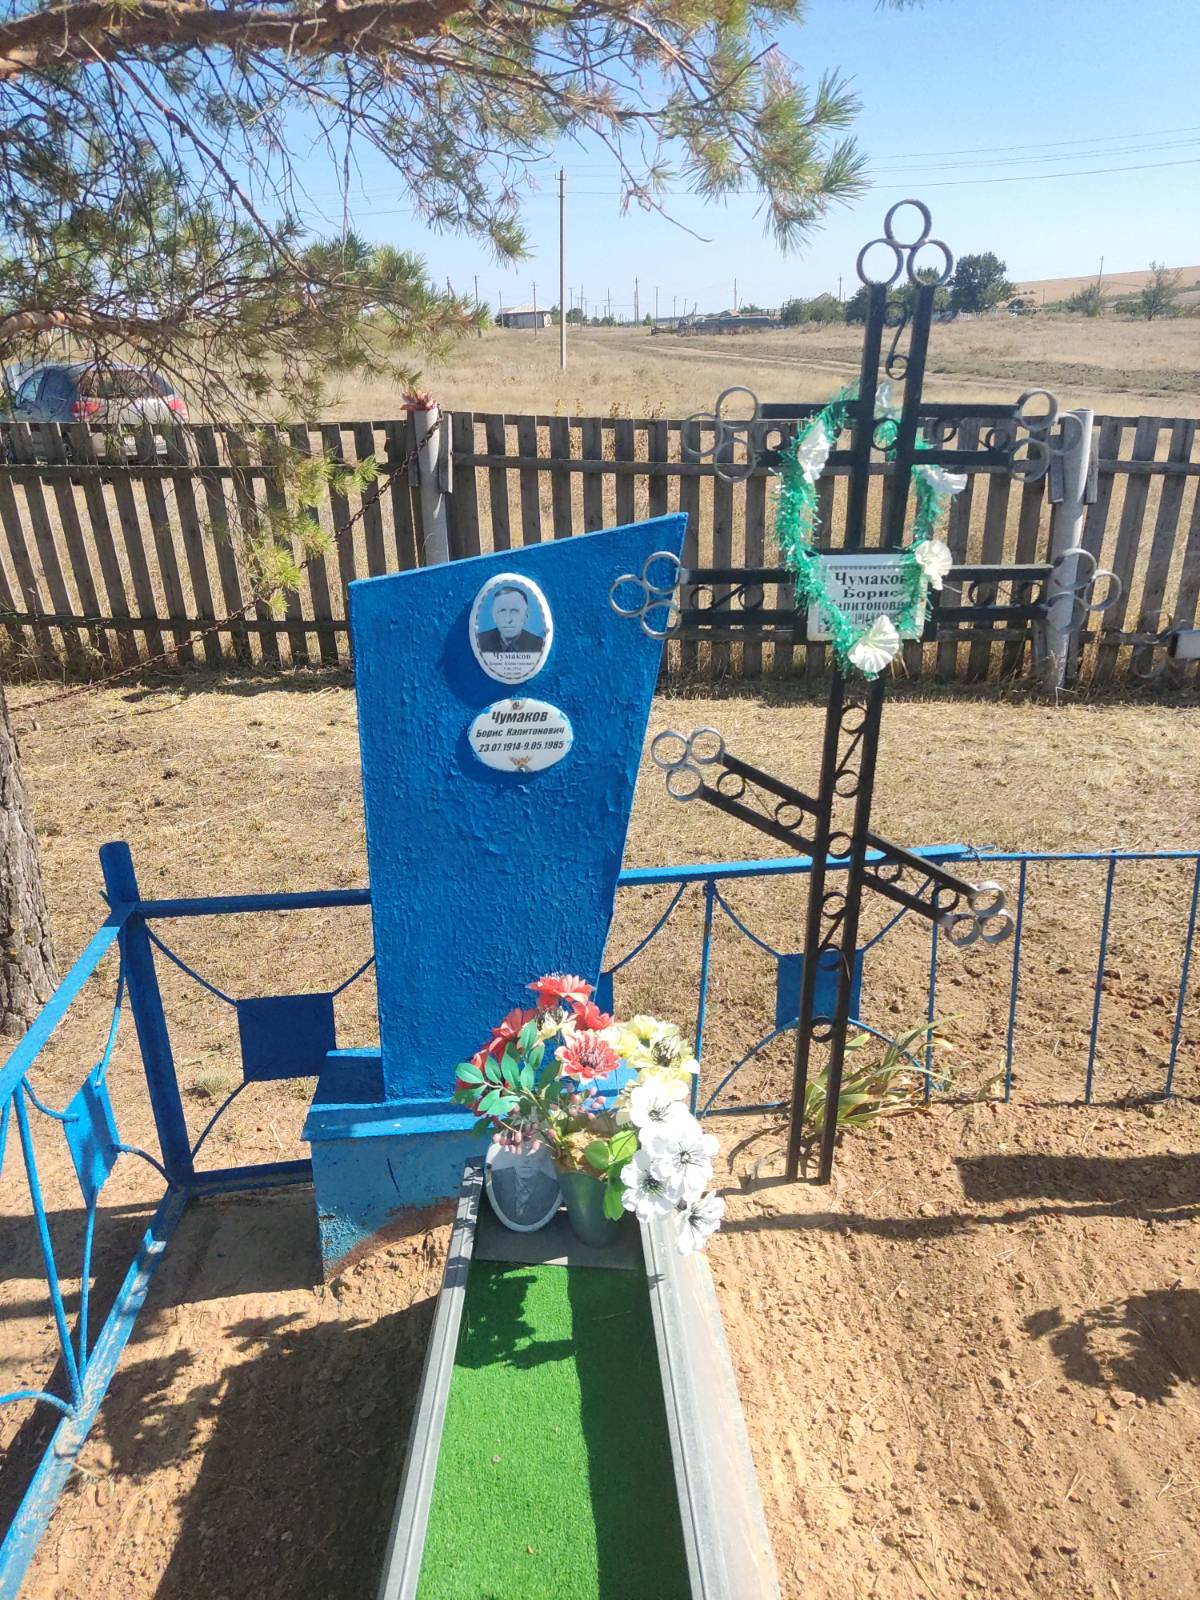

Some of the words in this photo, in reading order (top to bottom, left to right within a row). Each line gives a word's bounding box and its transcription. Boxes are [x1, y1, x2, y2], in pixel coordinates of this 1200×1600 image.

[843, 586, 901, 600] Борис
[491, 711, 548, 725] Чумаков
[476, 728, 503, 738] Борис
[506, 727, 565, 737] Капитонович
